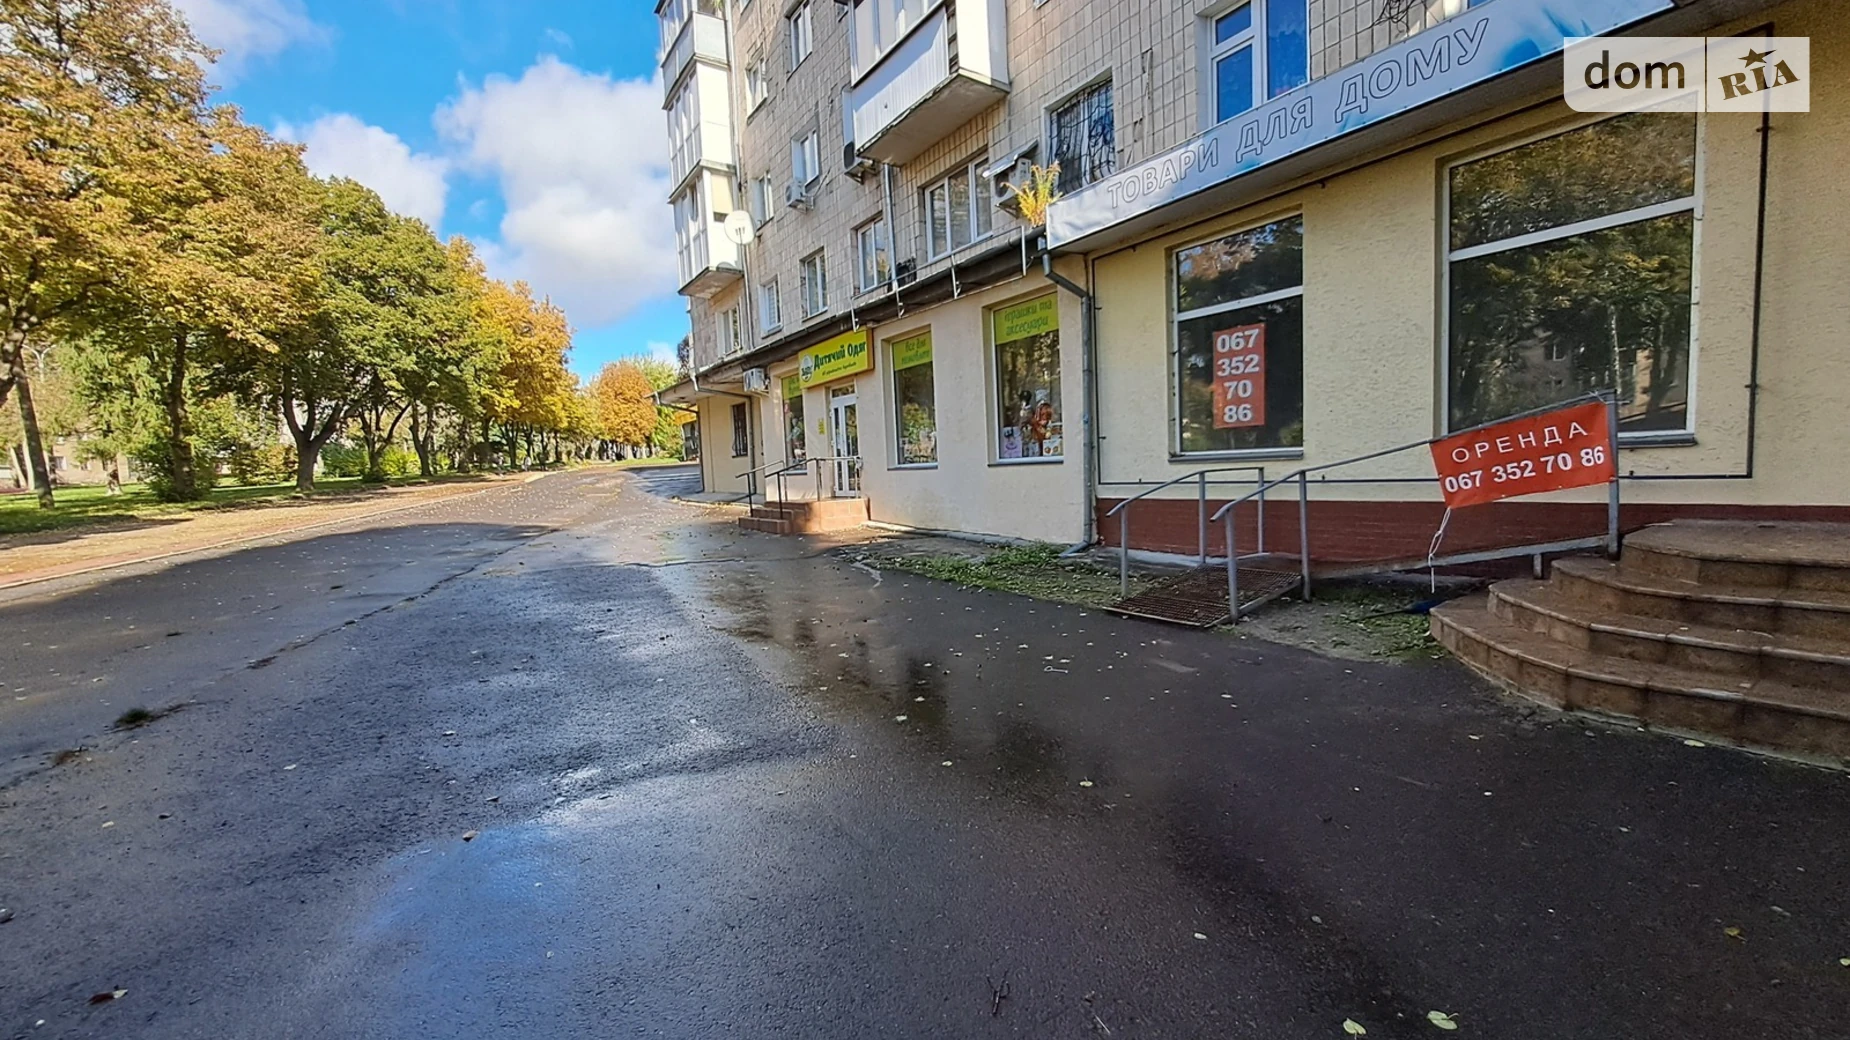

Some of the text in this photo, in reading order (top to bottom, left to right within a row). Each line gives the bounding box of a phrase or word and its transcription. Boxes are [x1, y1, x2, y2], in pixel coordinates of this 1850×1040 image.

[1108, 18, 1489, 208] ТОВАРИ ДЛЯ ДОМУ
[1216, 328, 1259, 353] 067
[813, 345, 846, 372] Дитячий
[1217, 354, 1260, 377] 352
[1223, 380, 1253, 400] 70
[1223, 403, 1253, 423] 86
[1452, 421, 1589, 464] ОРЕНДА
[1444, 446, 1605, 493] 067 352 70 86
